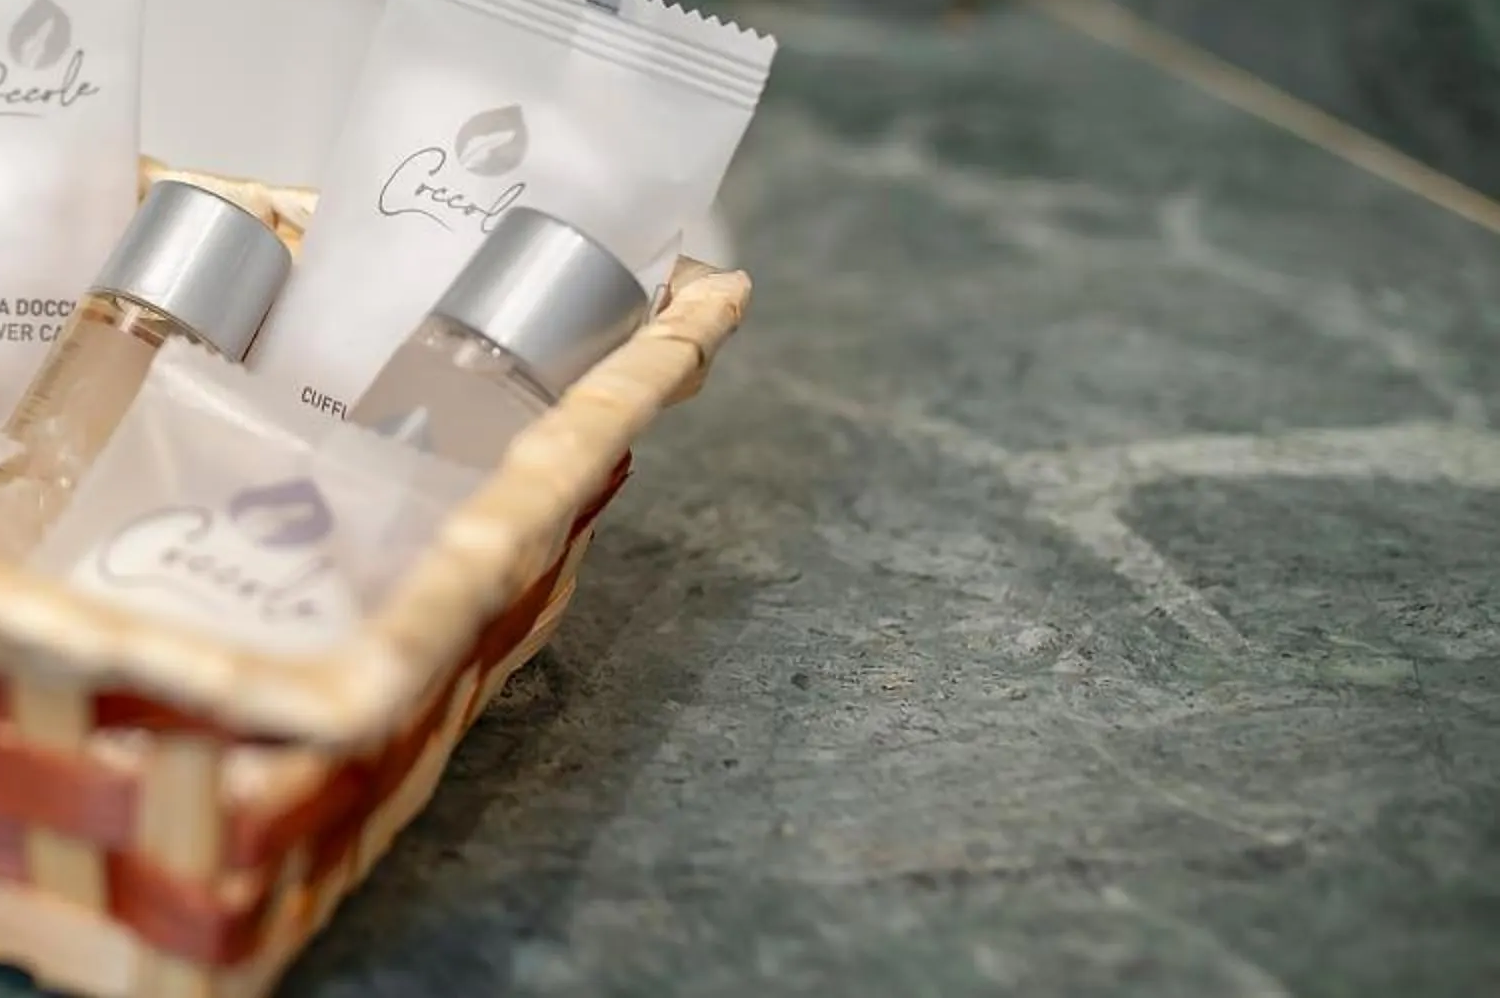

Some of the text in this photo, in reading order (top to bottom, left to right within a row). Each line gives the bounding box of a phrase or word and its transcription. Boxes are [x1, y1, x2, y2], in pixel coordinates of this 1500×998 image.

[378, 146, 527, 234] Coccol
[15, 298, 77, 317] DOCC
[301, 385, 348, 421] CUFFI
